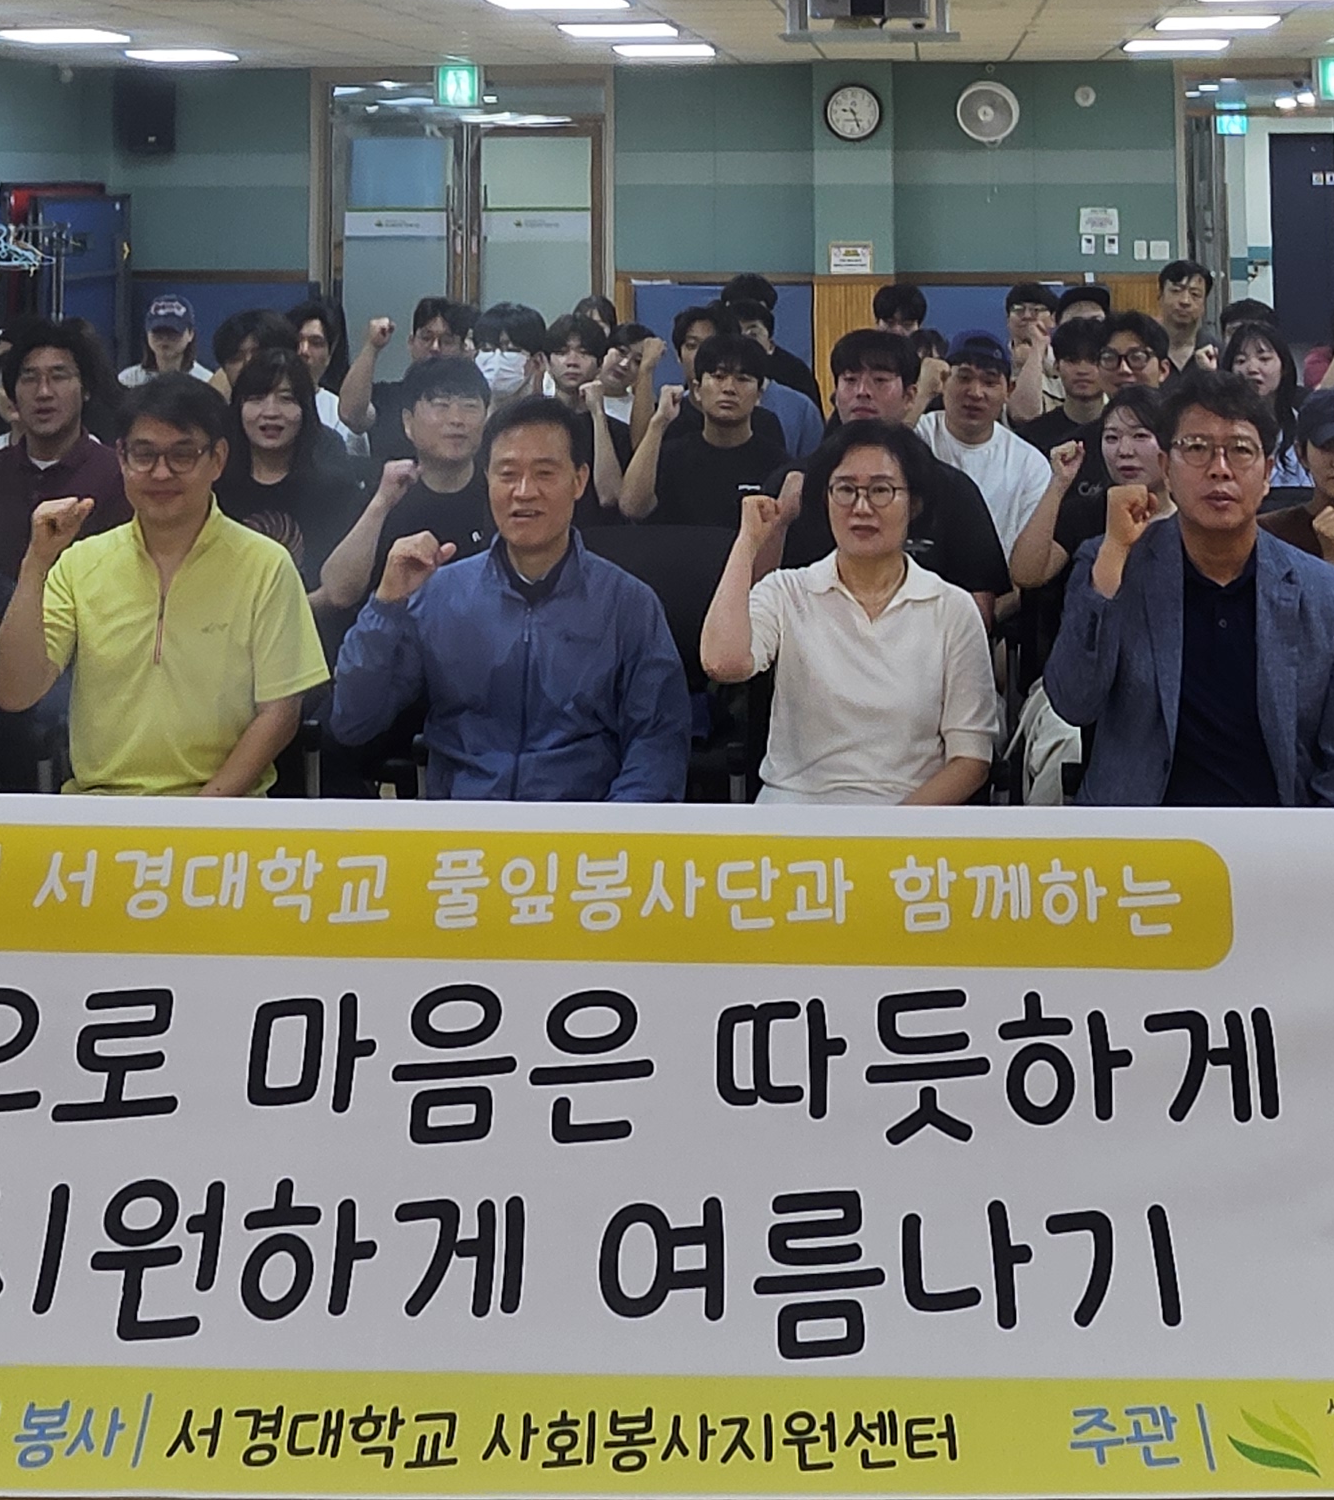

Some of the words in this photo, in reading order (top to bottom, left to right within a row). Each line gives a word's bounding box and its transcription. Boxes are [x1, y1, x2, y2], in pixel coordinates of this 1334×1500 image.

[32, 849, 391, 925] 서경대학교
[426, 847, 855, 933] 풀잎봉사단과
[889, 854, 1183, 938] 함께하는
[246, 983, 655, 1145] 마음은
[715, 987, 1281, 1146] 따듯하게
[597, 1188, 1184, 1361] 여름나기
[13, 1399, 127, 1470] 봉사
[164, 1403, 459, 1471] 서경대학교
[481, 1406, 961, 1473] 사회봉사지원센터
[1069, 1402, 1179, 1470] 주관
